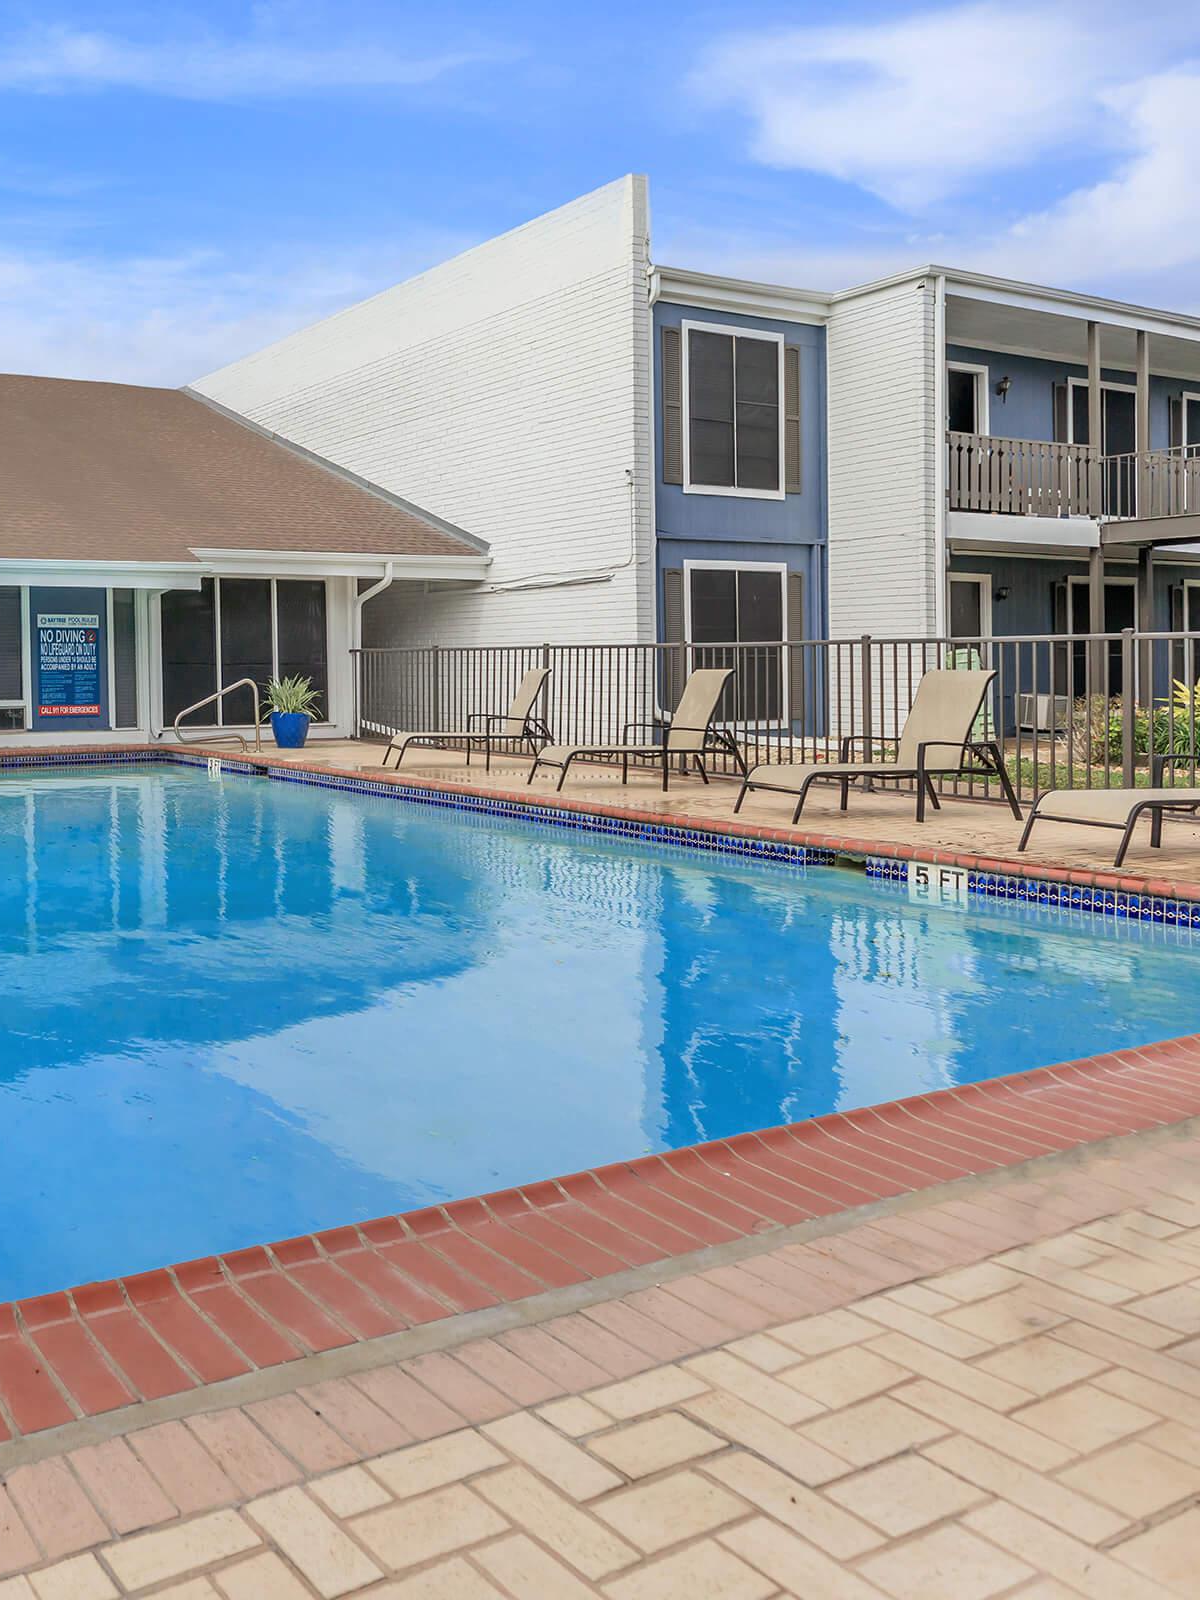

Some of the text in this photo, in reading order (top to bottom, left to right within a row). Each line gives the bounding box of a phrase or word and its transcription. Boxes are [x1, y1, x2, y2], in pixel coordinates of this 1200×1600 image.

[40, 630, 85, 642] NO DIVING
[40, 643, 96, 655] NO LIFEGUARD ON DUTY
[40, 663, 70, 671] ACCOMPANIED
[41, 706, 52, 714] CALL
[60, 706, 69, 714] FOR
[69, 706, 98, 714] EMERGENCIES
[916, 866, 963, 889] 5 FT
